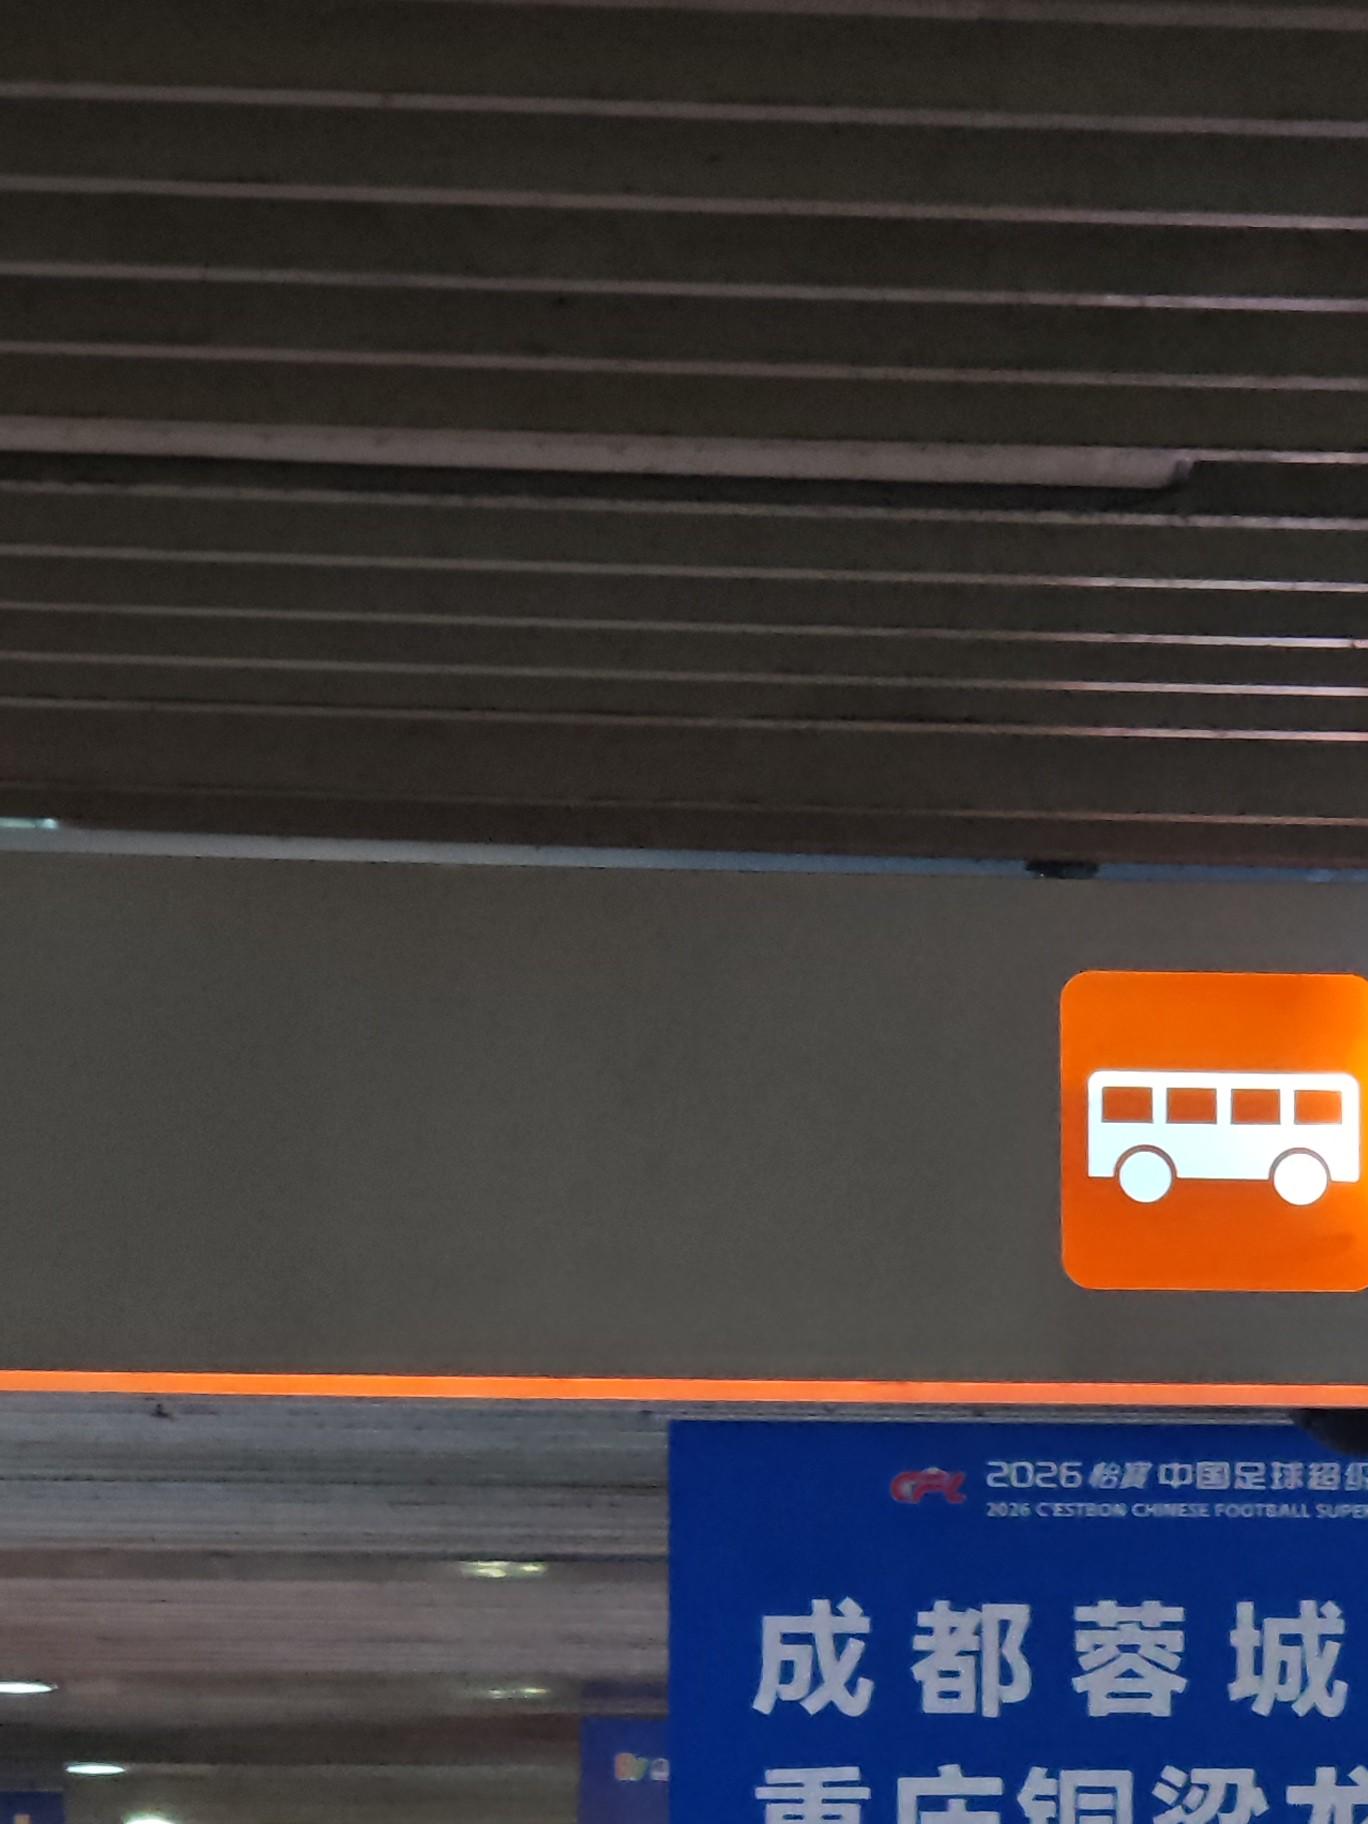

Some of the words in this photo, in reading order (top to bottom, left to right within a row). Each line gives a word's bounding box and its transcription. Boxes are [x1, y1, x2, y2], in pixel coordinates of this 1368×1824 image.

[986, 1460, 1082, 1488] 2026
[1131, 1502, 1210, 1518] CHINESE
[1215, 1502, 1310, 1518] FOOTBALL
